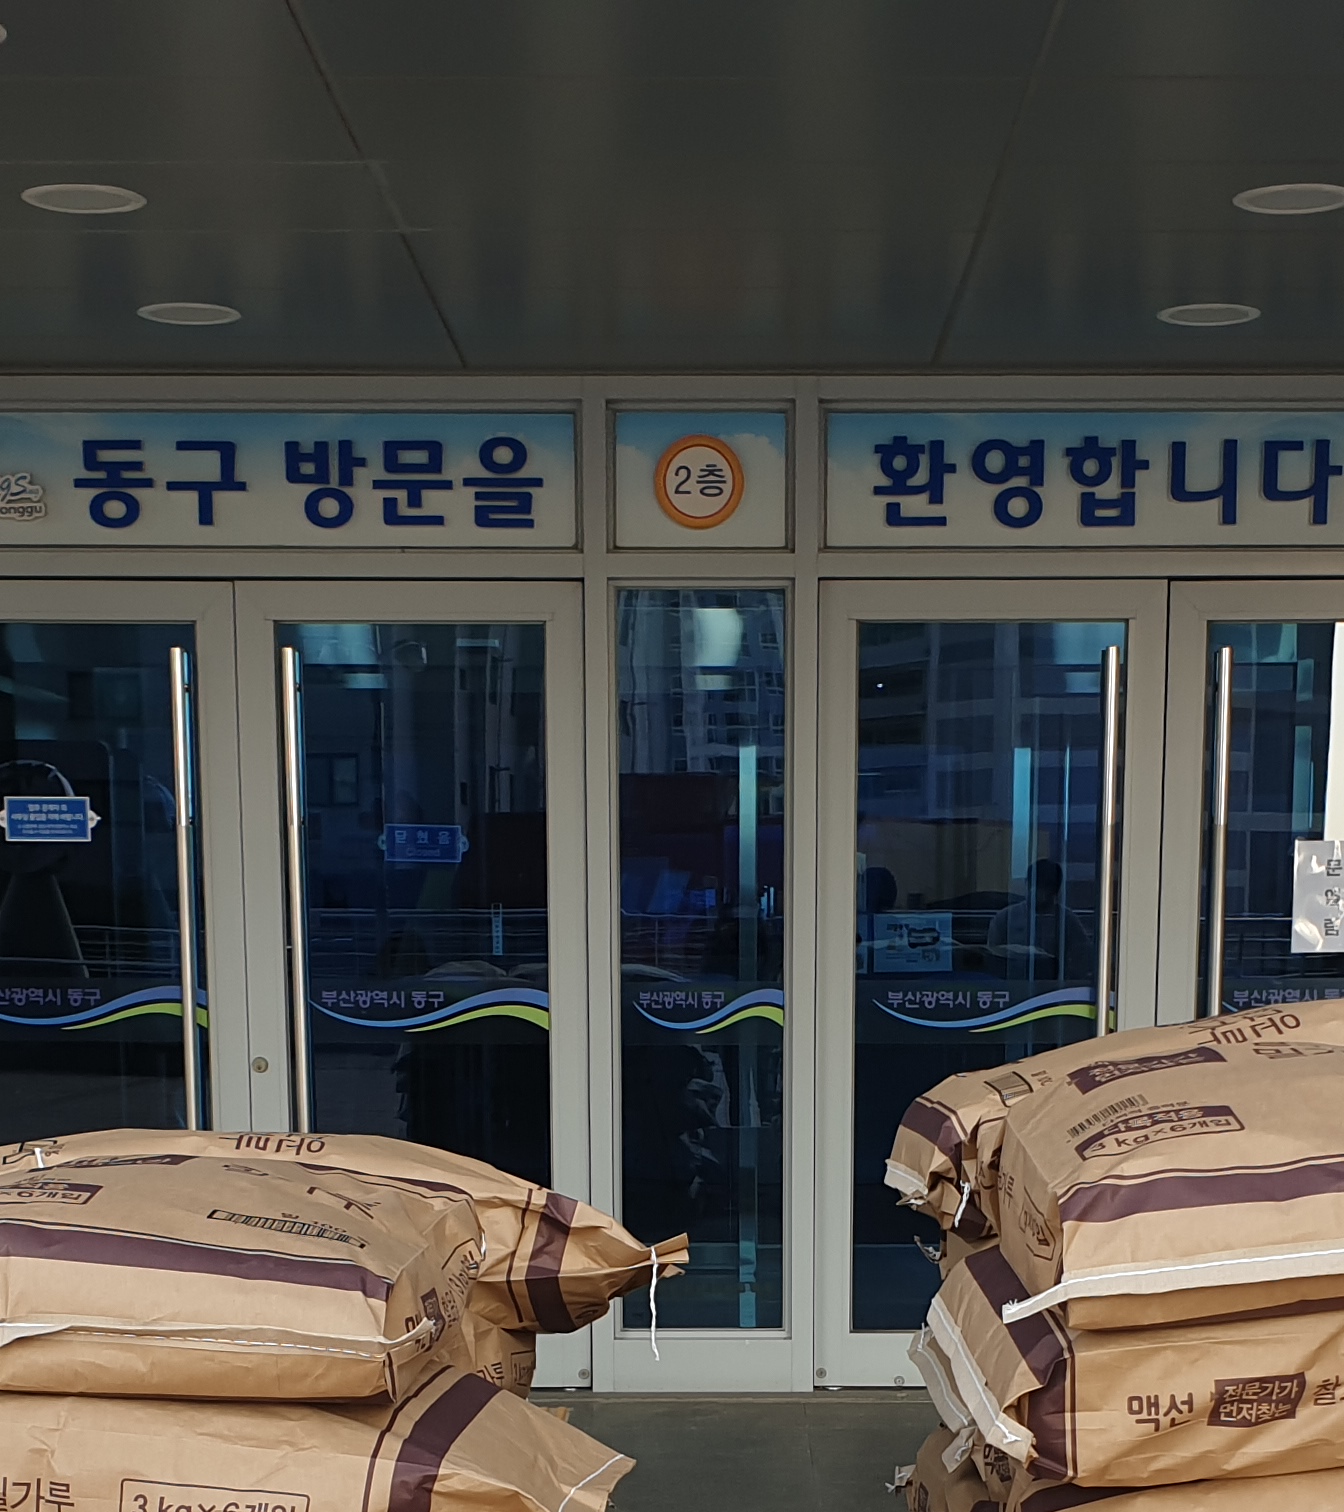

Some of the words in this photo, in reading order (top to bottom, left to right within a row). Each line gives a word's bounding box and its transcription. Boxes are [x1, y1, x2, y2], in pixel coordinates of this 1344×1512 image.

[74, 439, 248, 529] 동구
[285, 436, 544, 529] 방문을
[673, 464, 727, 499] 2층
[872, 435, 1343, 528] 환영합니다
[68, 987, 101, 1006] 동구
[321, 990, 406, 1009] 부산광역시
[411, 990, 444, 1008] 동구
[639, 990, 697, 1009] 부산광역시
[701, 991, 725, 1009] 동구
[887, 990, 972, 1010] 부산광역시
[977, 990, 1010, 1010] 동구
[1126, 1393, 1198, 1429] 맥선
